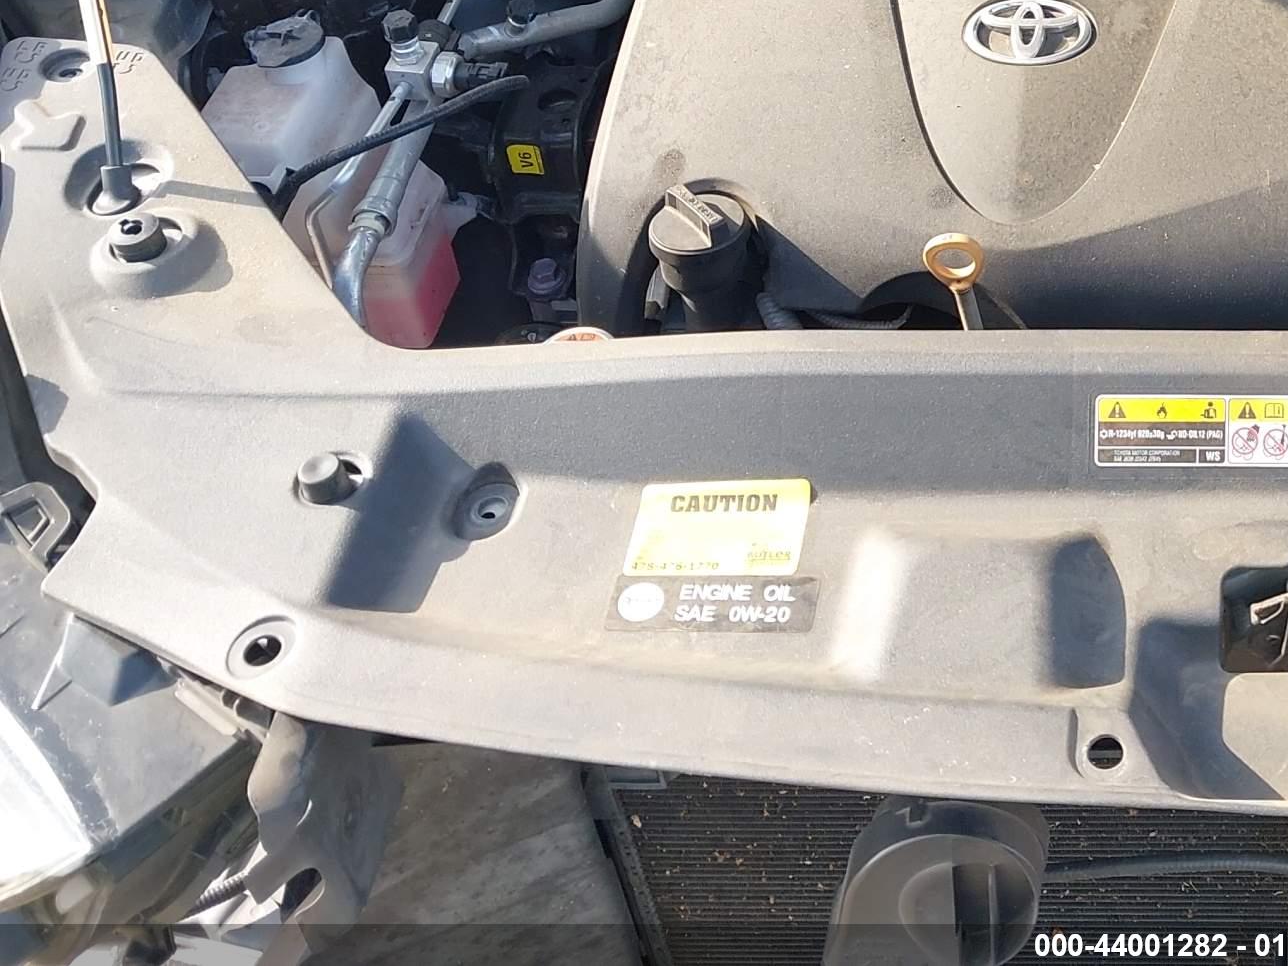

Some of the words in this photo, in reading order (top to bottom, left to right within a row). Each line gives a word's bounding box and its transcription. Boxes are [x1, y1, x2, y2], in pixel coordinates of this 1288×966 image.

[518, 152, 534, 168] V6
[1205, 450, 1221, 462] WS
[670, 493, 778, 513] CAUTION
[679, 584, 752, 601] ENGINE
[763, 584, 796, 602] OIL
[674, 605, 717, 622] SAE
[728, 605, 791, 623] 0W-20
